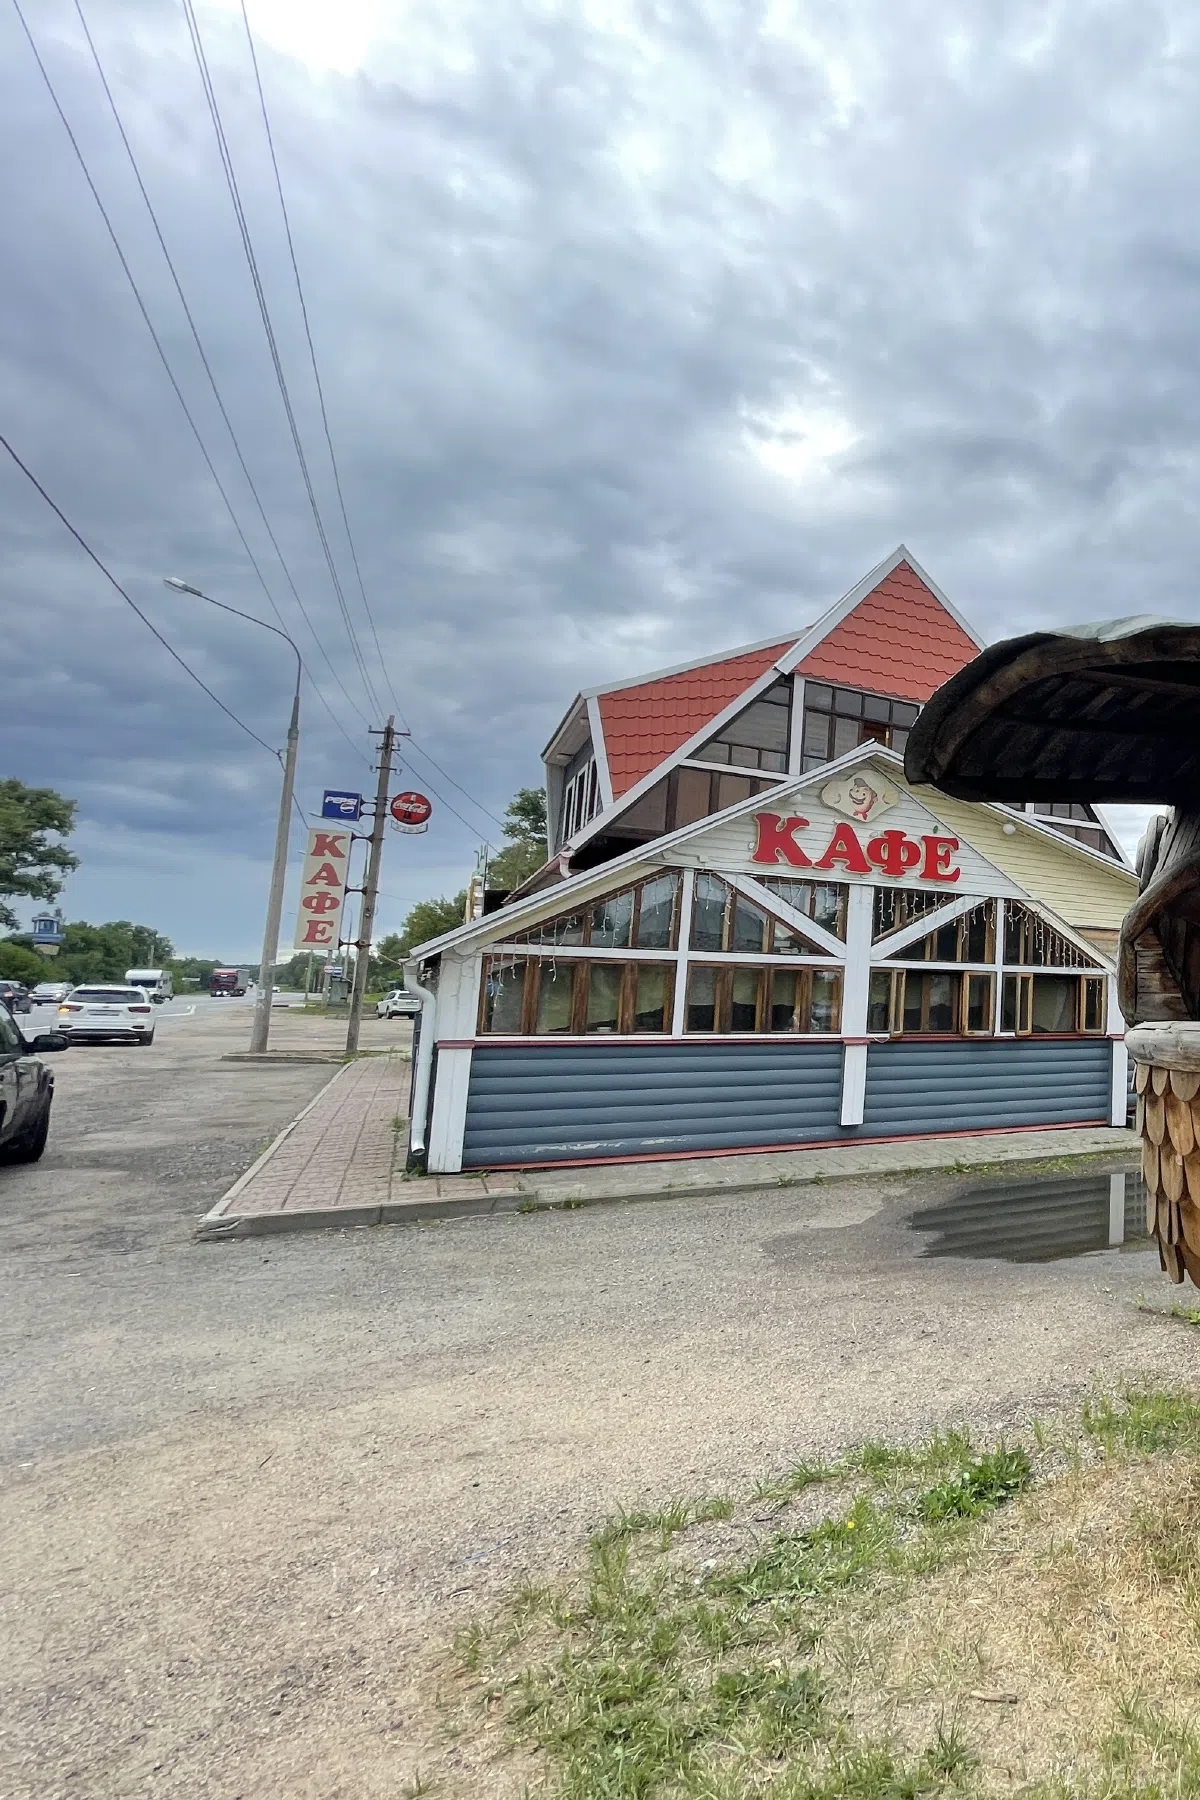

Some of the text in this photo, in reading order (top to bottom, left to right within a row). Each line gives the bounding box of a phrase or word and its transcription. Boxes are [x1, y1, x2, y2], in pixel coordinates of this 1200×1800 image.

[324, 796, 358, 805] PEPSI
[751, 812, 961, 883] КАФЕ
[301, 833, 347, 944] КАФЕ
